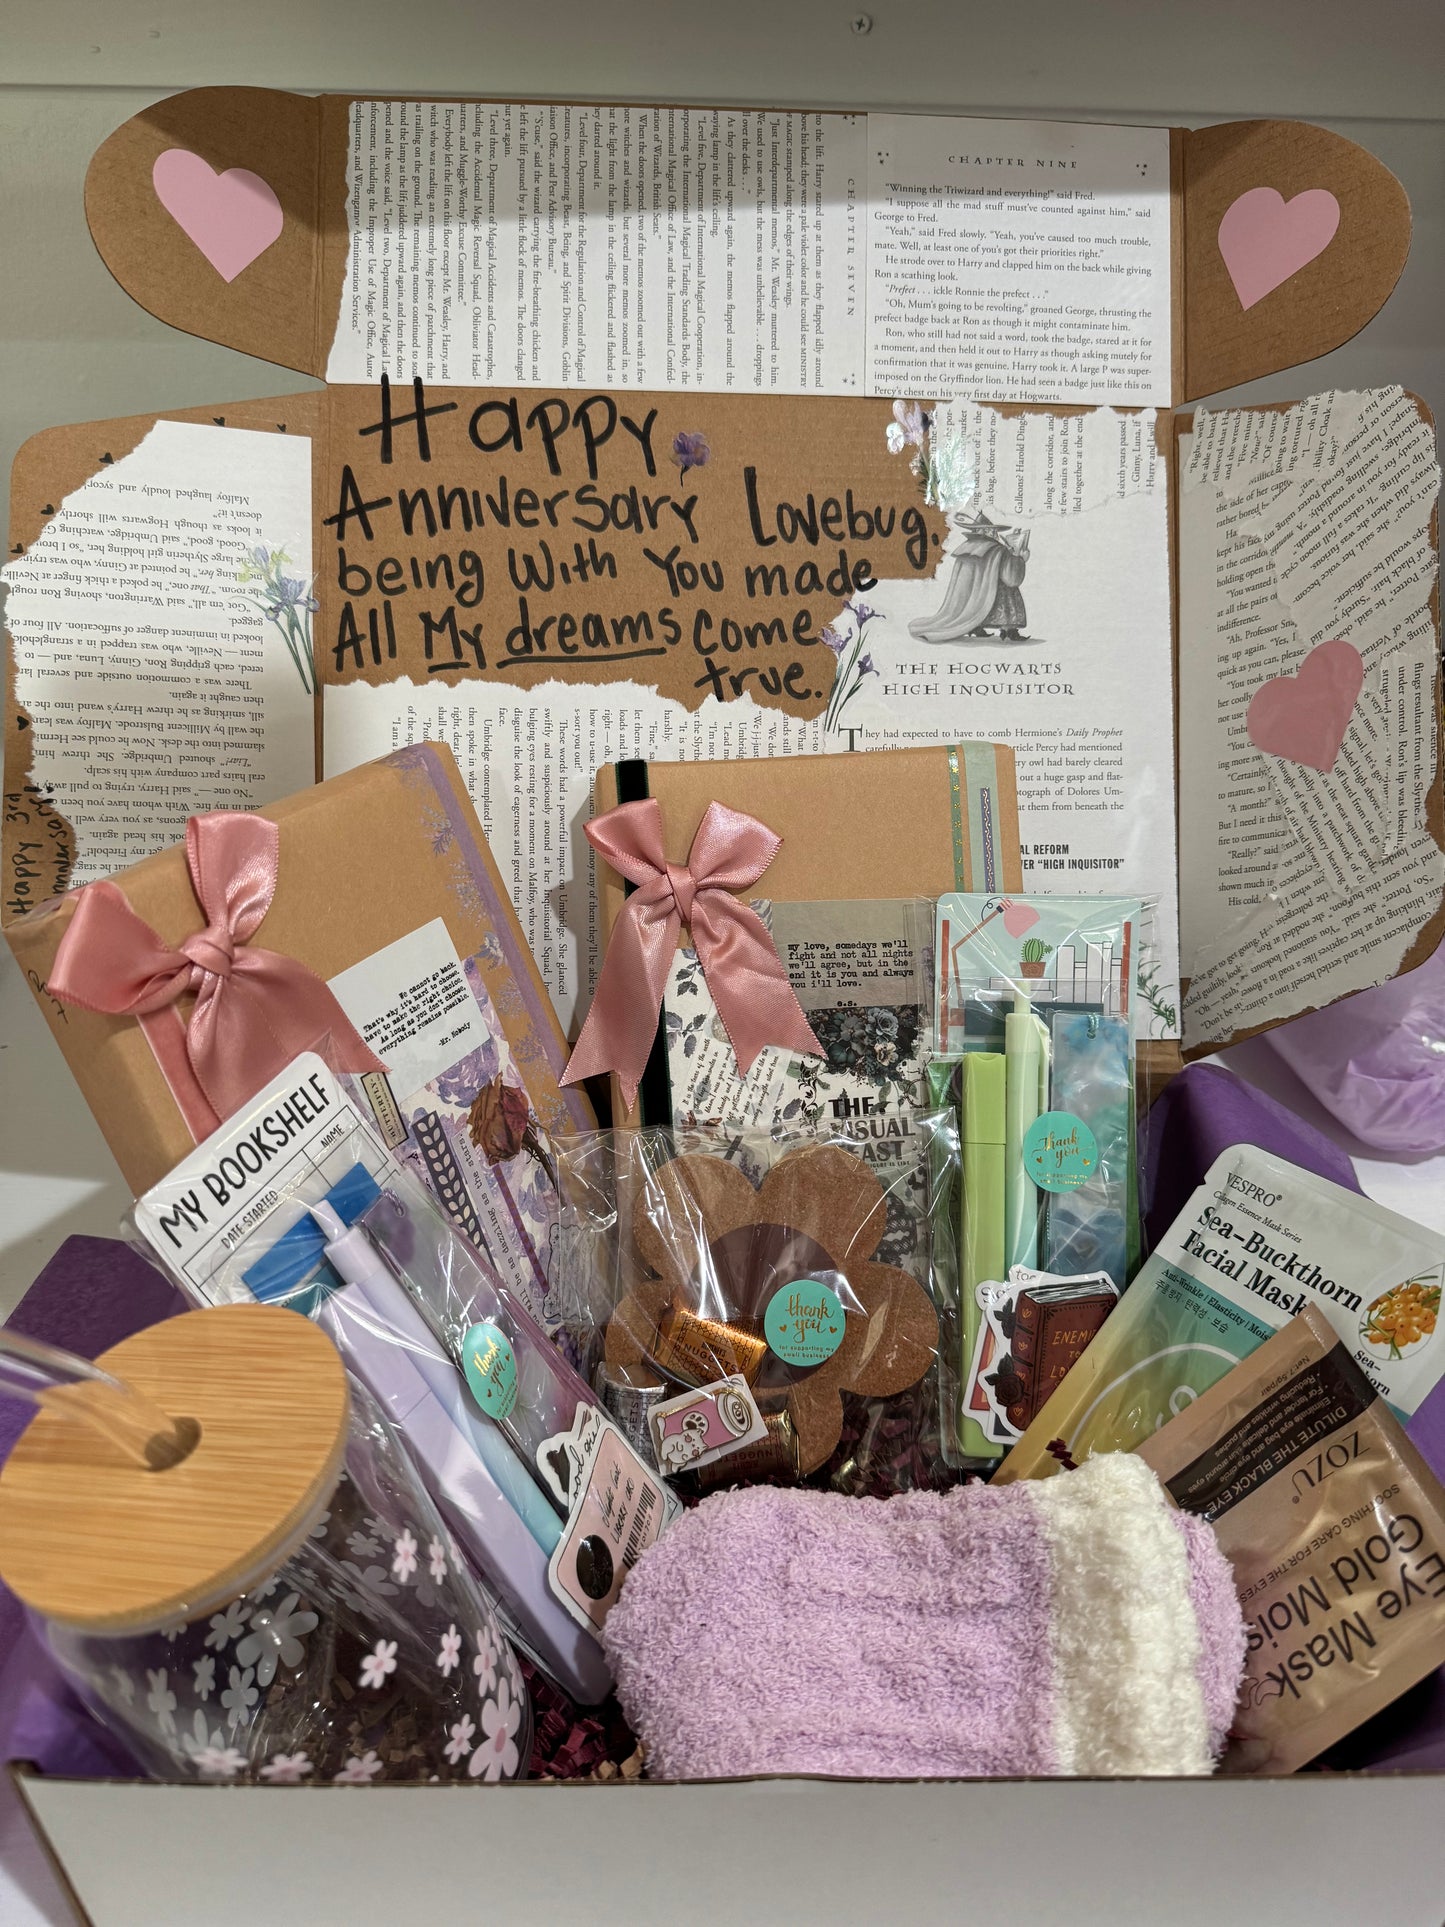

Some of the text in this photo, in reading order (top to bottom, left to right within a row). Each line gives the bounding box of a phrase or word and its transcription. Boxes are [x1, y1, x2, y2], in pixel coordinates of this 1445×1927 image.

[948, 155, 1077, 169] CHAPTER NINE
[874, 211, 905, 224] George
[917, 212, 939, 223] Fred.
[846, 177, 856, 316] CHAPTER SEVEN
[359, 372, 659, 480] Happy
[118, 484, 250, 506] Malfoy laughed loudly and
[322, 464, 940, 570] Anniversary Lovebug.
[332, 597, 820, 673] All My dreams come
[694, 660, 823, 703] true.
[895, 662, 1062, 676] THE HOGWARTS
[882, 683, 1075, 697] HIGH INQUISITOR
[559, 719, 569, 745] These
[883, 728, 900, 738] had
[901, 728, 939, 741] expected
[953, 728, 974, 738] have
[975, 730, 985, 738] to
[987, 727, 1012, 738] comb
[1015, 727, 1063, 737] Hermione’s
[1065, 727, 1089, 739] Daily
[1091, 727, 1123, 739] Prophet
[559, 747, 569, 774] words
[559, 776, 569, 793] had
[556, 803, 569, 843] powerful
[4, 793, 43, 914] Happy 3rd
[24, 786, 71, 902] nniversary!
[1033, 844, 1069, 855] REFORM
[556, 846, 568, 876] impact
[558, 879, 565, 891] on
[555, 894, 569, 940] Umbridge.
[556, 943, 568, 960] She
[787, 939, 909, 953] my love, somedays we'll
[788, 948, 914, 963] fight and not all nights
[787, 957, 909, 971] we'll agree, but in the
[788, 968, 914, 980] end it is you and always
[398, 961, 457, 1000] We cannot go back.
[555, 961, 568, 996] glanced
[811, 979, 833, 989] i'll
[836, 978, 862, 988] love.
[363, 970, 460, 1033] That's why it's hard to choose.
[363, 977, 463, 1043] have to make the right choice.
[380, 985, 467, 1044] As long as you don't choose,
[378, 993, 470, 1055] everything remains possible.
[320, 1123, 345, 1149] NAME
[159, 1190, 209, 1249] MY
[202, 1073, 330, 1207] BOOKSHELF
[1055, 1147, 1080, 1169] you
[220, 1189, 281, 1250] DATE STARTED
[1236, 1202, 1303, 1244] Essence Mask Series
[1180, 1229, 1248, 1283] Facial
[785, 1293, 835, 1321] thank
[793, 1319, 827, 1344] you
[1052, 1329, 1096, 1346] ENEMI
[1209, 1406, 1348, 1512] DILUTE THE BLACK EYE
[1310, 1524, 1342, 1551] CARE
[1287, 1545, 1313, 1567] FOR
[1244, 1514, 1424, 1653] Gold Mois
[1266, 1563, 1290, 1584] THE
[1239, 1577, 1268, 1604] EYES
[1264, 1611, 1377, 1700] Mask
